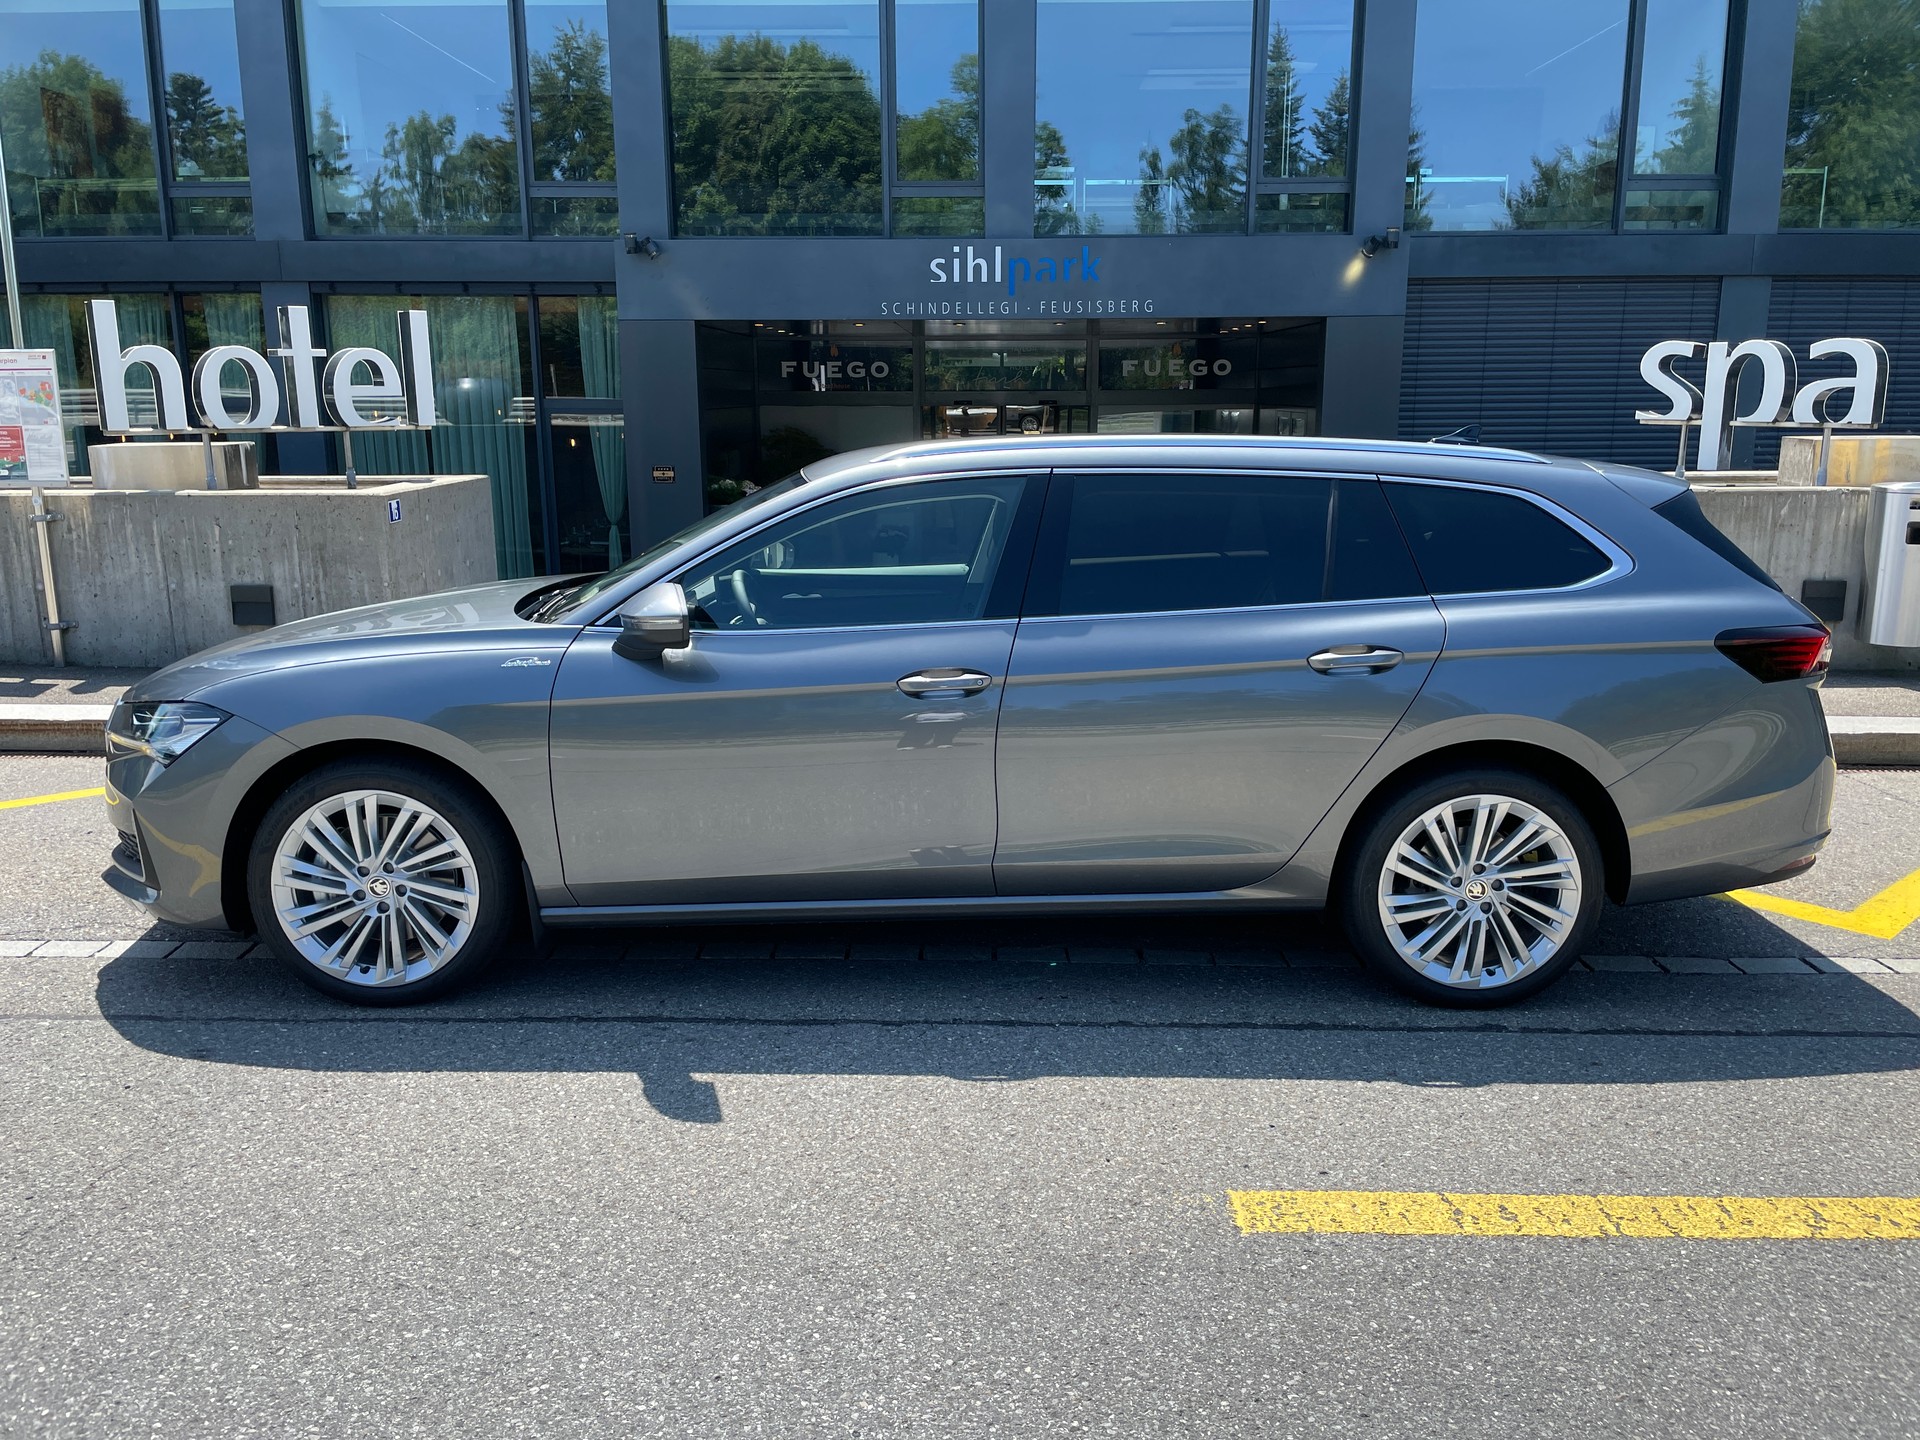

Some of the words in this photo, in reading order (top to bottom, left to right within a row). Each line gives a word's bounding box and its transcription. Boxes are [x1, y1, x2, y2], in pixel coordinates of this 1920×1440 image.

[881, 301, 1019, 316] SCHINDELLEGI
[1039, 300, 1154, 314] FEUSISBERG
[85, 299, 437, 432] hotel
[780, 361, 889, 378] FUEGO
[1121, 359, 1232, 376] FUEGO
[1635, 337, 1890, 470] spa
